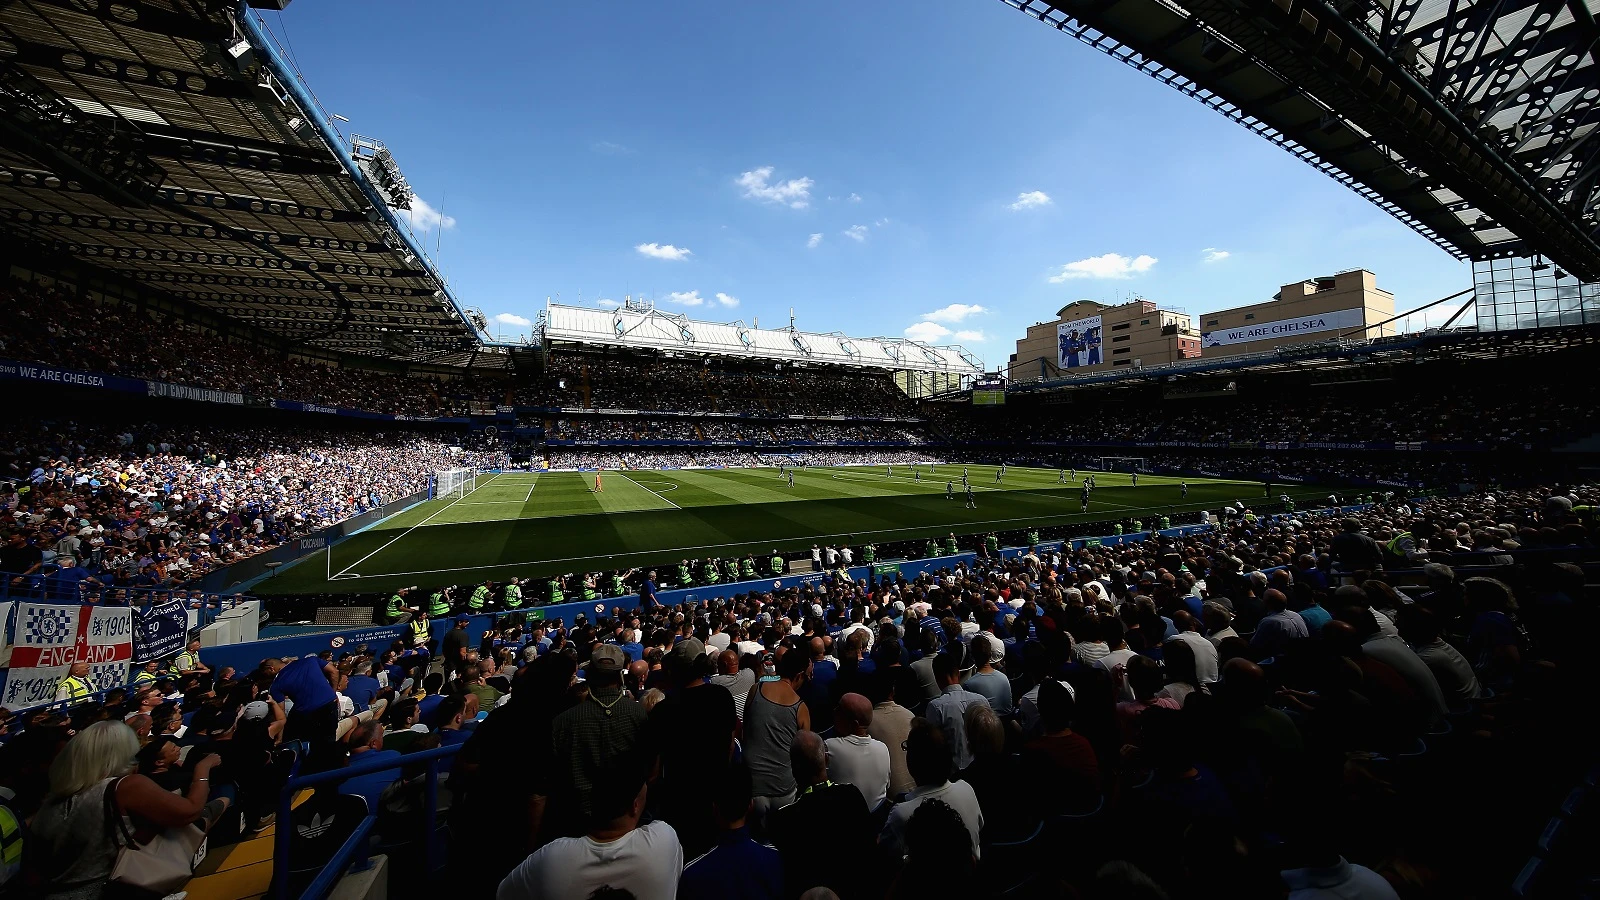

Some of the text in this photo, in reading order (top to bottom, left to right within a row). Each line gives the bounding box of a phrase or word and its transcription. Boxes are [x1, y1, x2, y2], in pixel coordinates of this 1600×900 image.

[1228, 319, 1326, 340] WE ARE CHELSEA
[20, 366, 38, 378] WE
[39, 369, 61, 381] ARE
[63, 372, 104, 386] CHELSEA
[36, 645, 116, 668] ENGLAND
